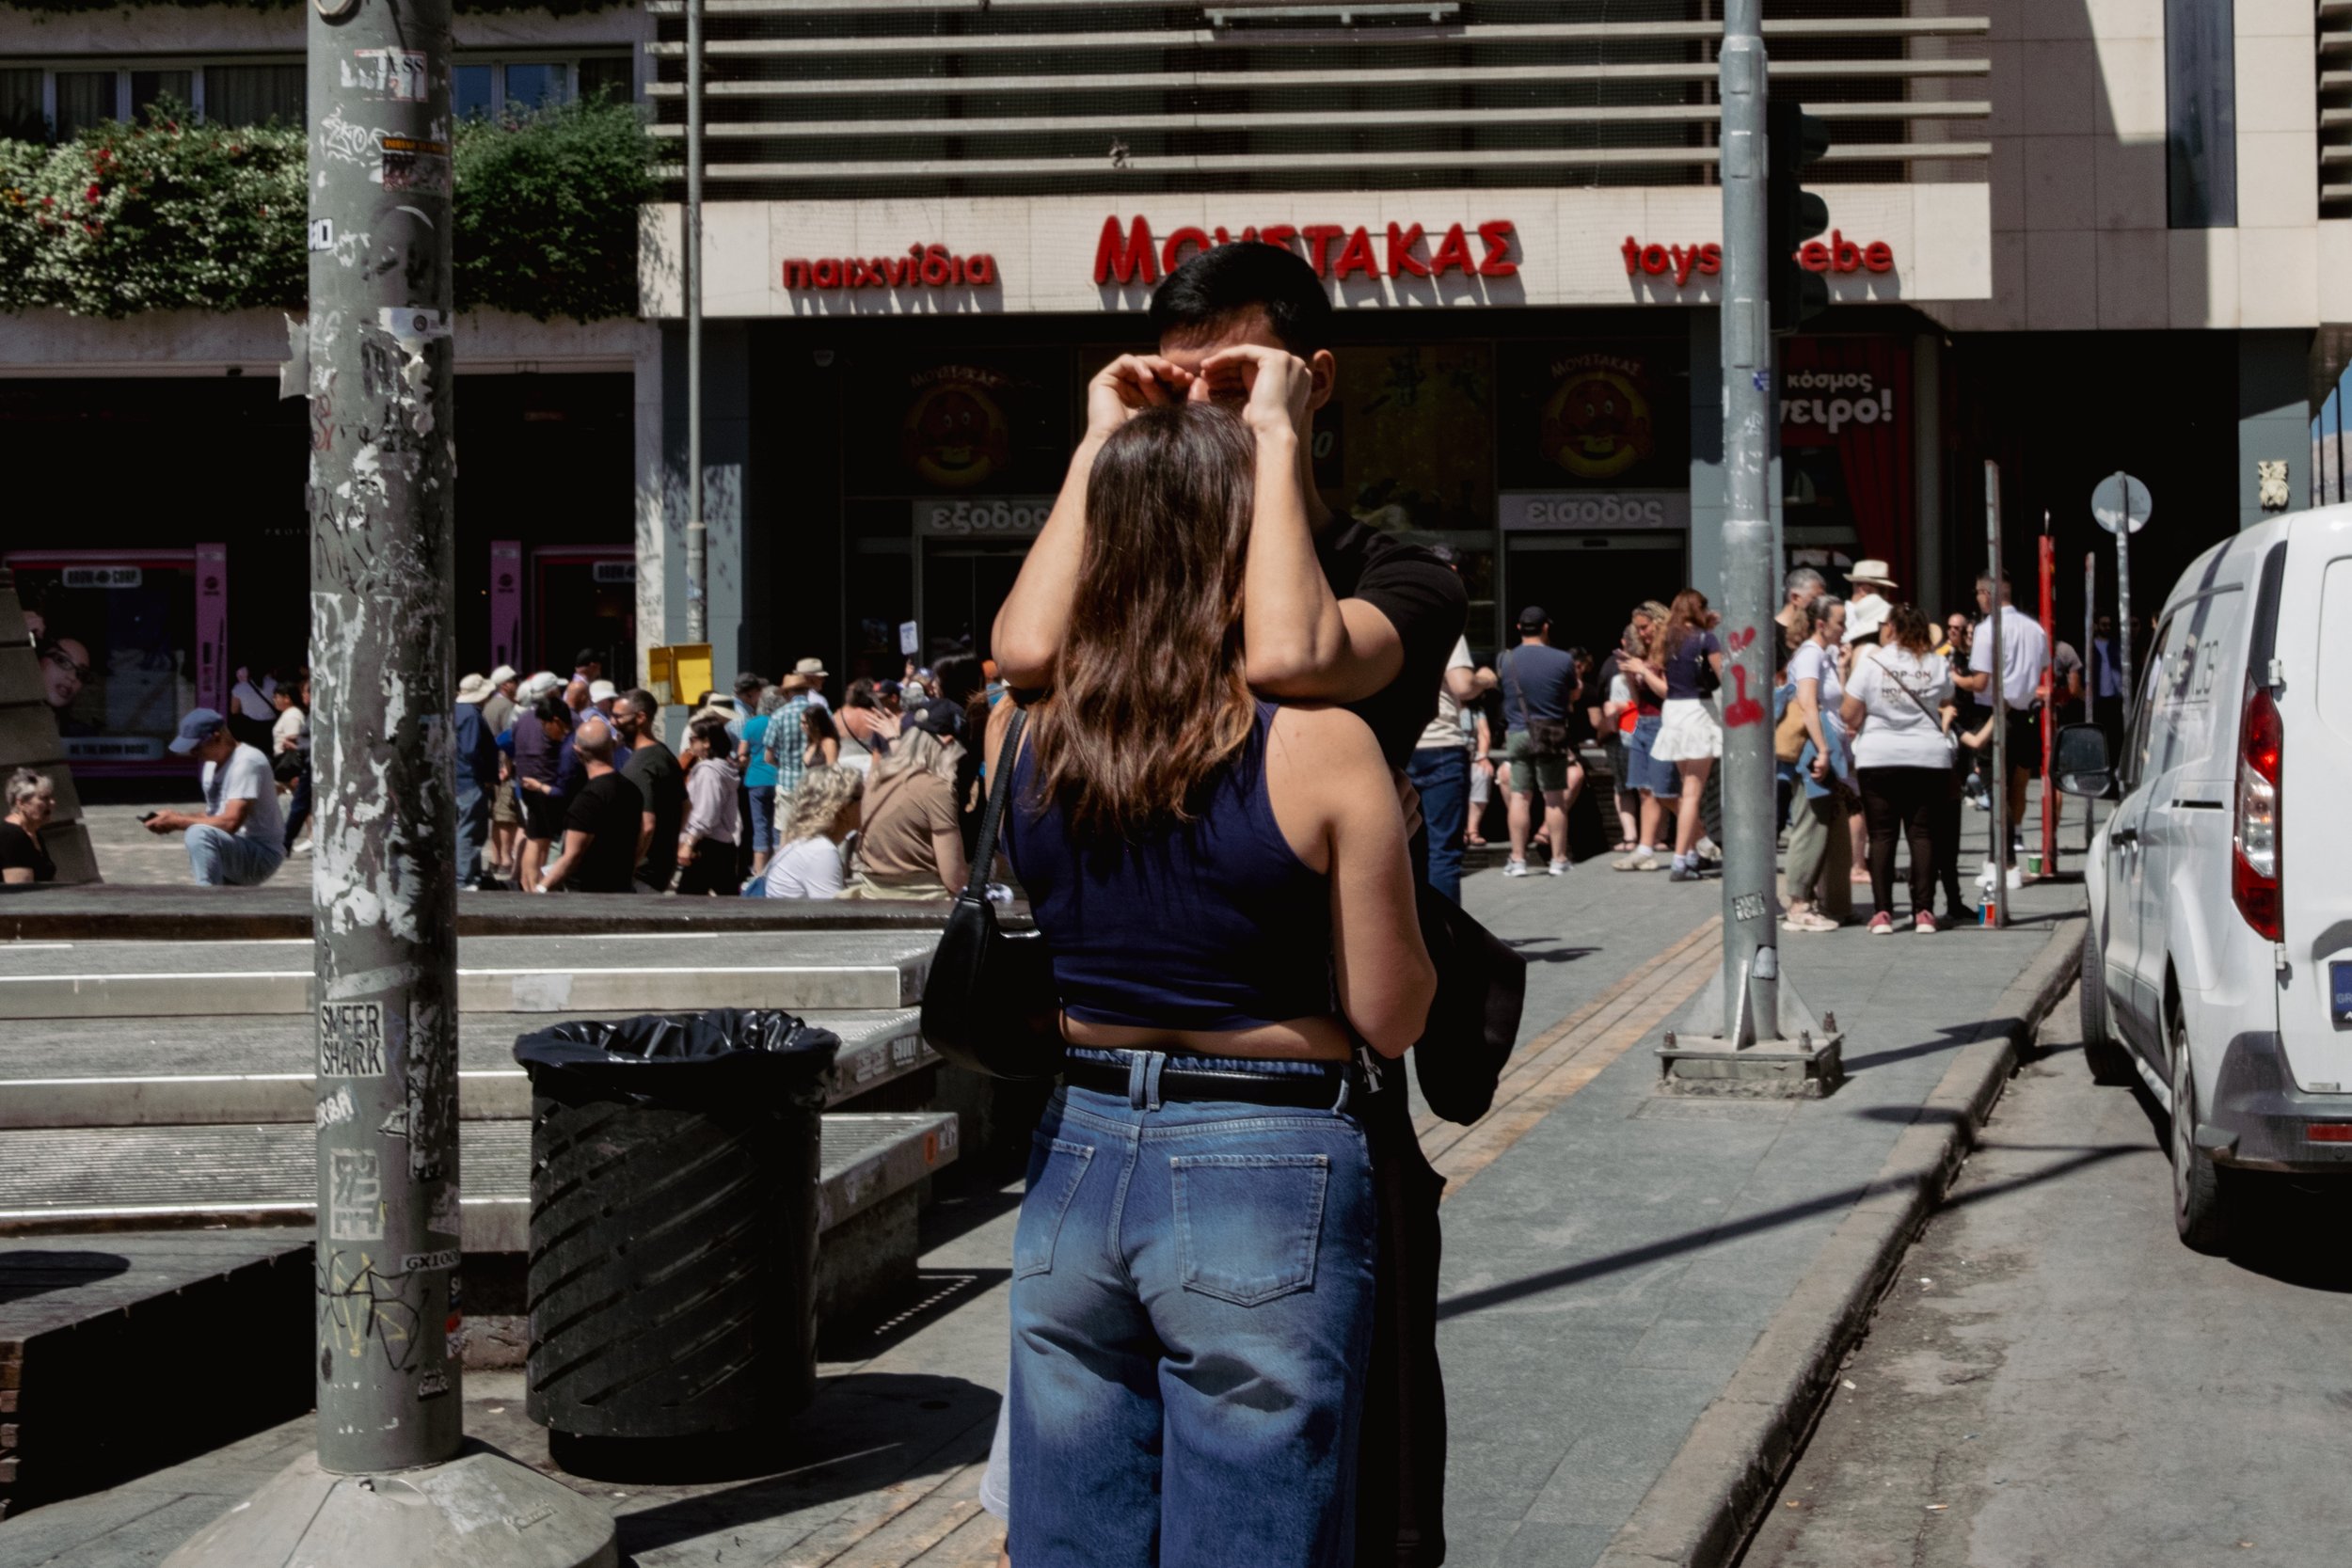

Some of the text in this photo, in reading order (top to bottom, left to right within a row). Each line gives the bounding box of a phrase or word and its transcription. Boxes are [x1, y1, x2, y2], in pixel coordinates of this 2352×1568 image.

[783, 243, 994, 291] παιχνίδια
[1621, 229, 1894, 286] toys ebe
[1787, 370, 1873, 394] κόσμος
[1526, 494, 1663, 527] εισοδος
